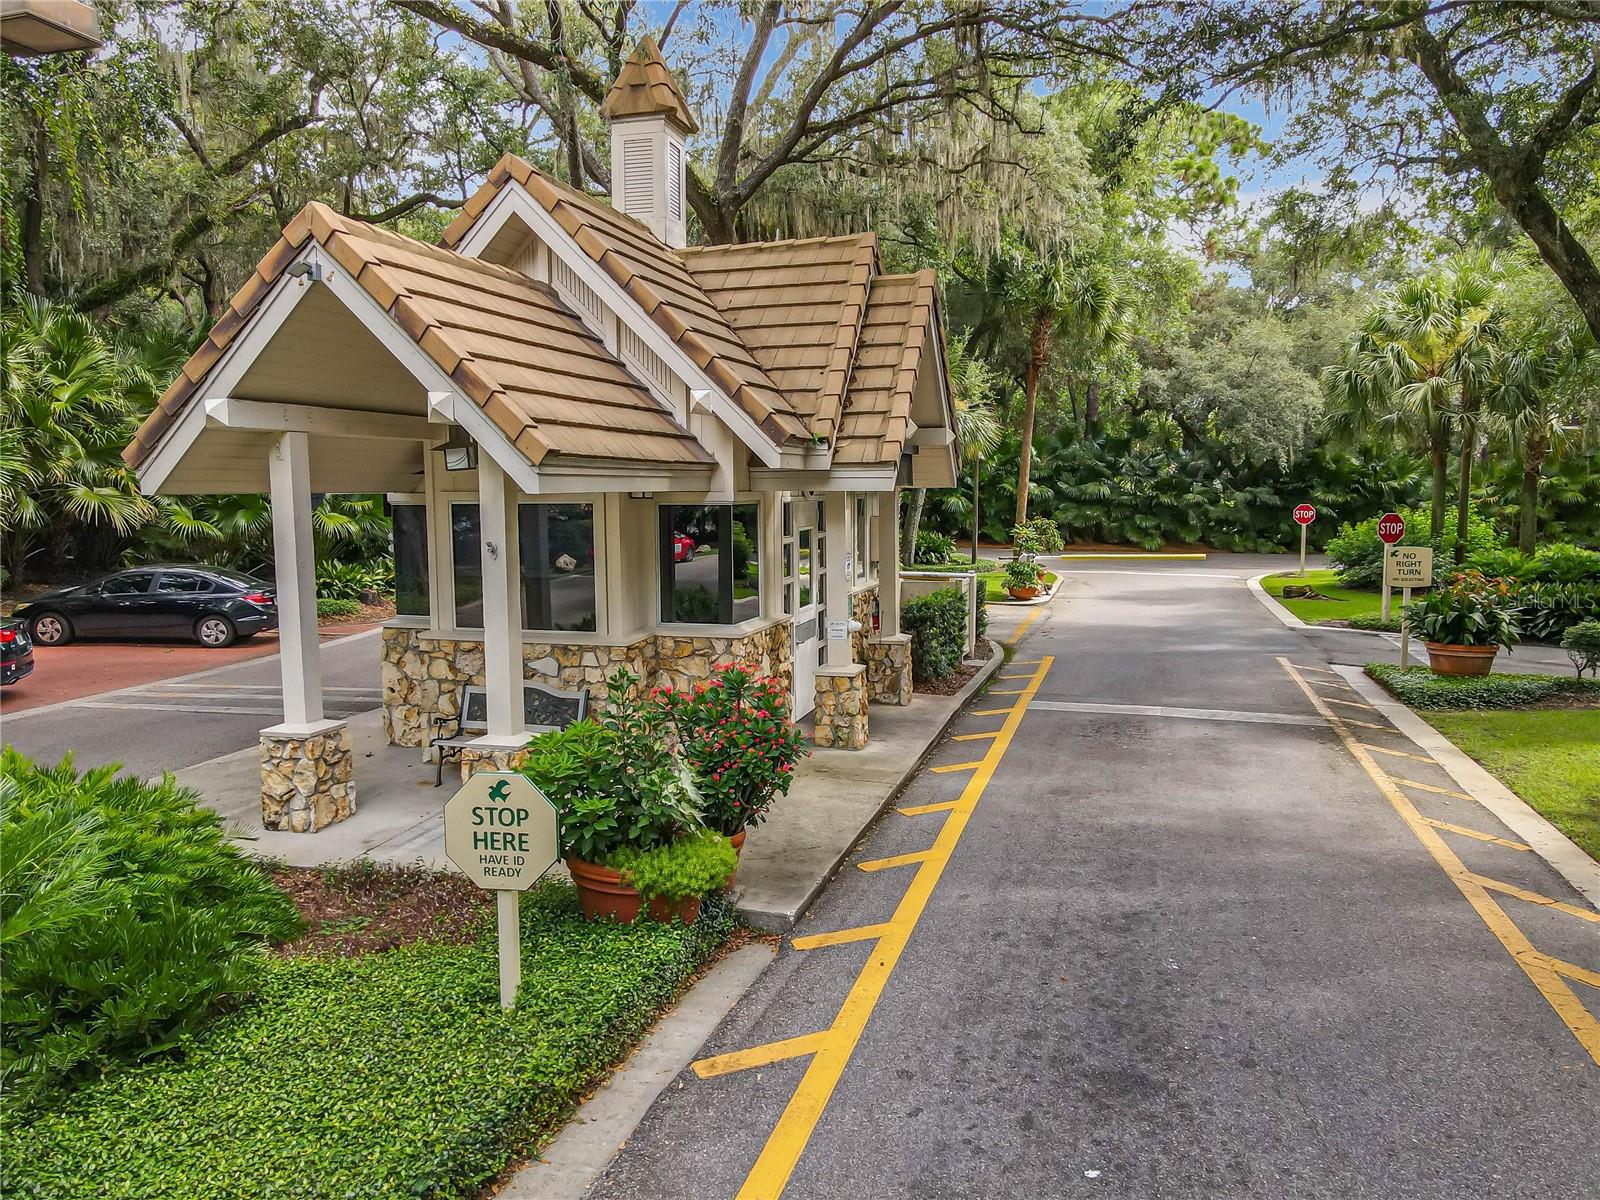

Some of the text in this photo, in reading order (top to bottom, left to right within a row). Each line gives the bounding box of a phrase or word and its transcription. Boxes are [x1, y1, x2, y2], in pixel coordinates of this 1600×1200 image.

[1294, 510, 1314, 518] STOP
[1379, 523, 1403, 534] STOP
[1402, 552, 1417, 560] NO
[1395, 560, 1423, 568] RIGHT
[1397, 568, 1422, 576] TURN
[471, 806, 529, 827] STOP
[472, 831, 530, 852] HERE
[479, 854, 525, 866] HAVE ID
[483, 866, 522, 877] READY
